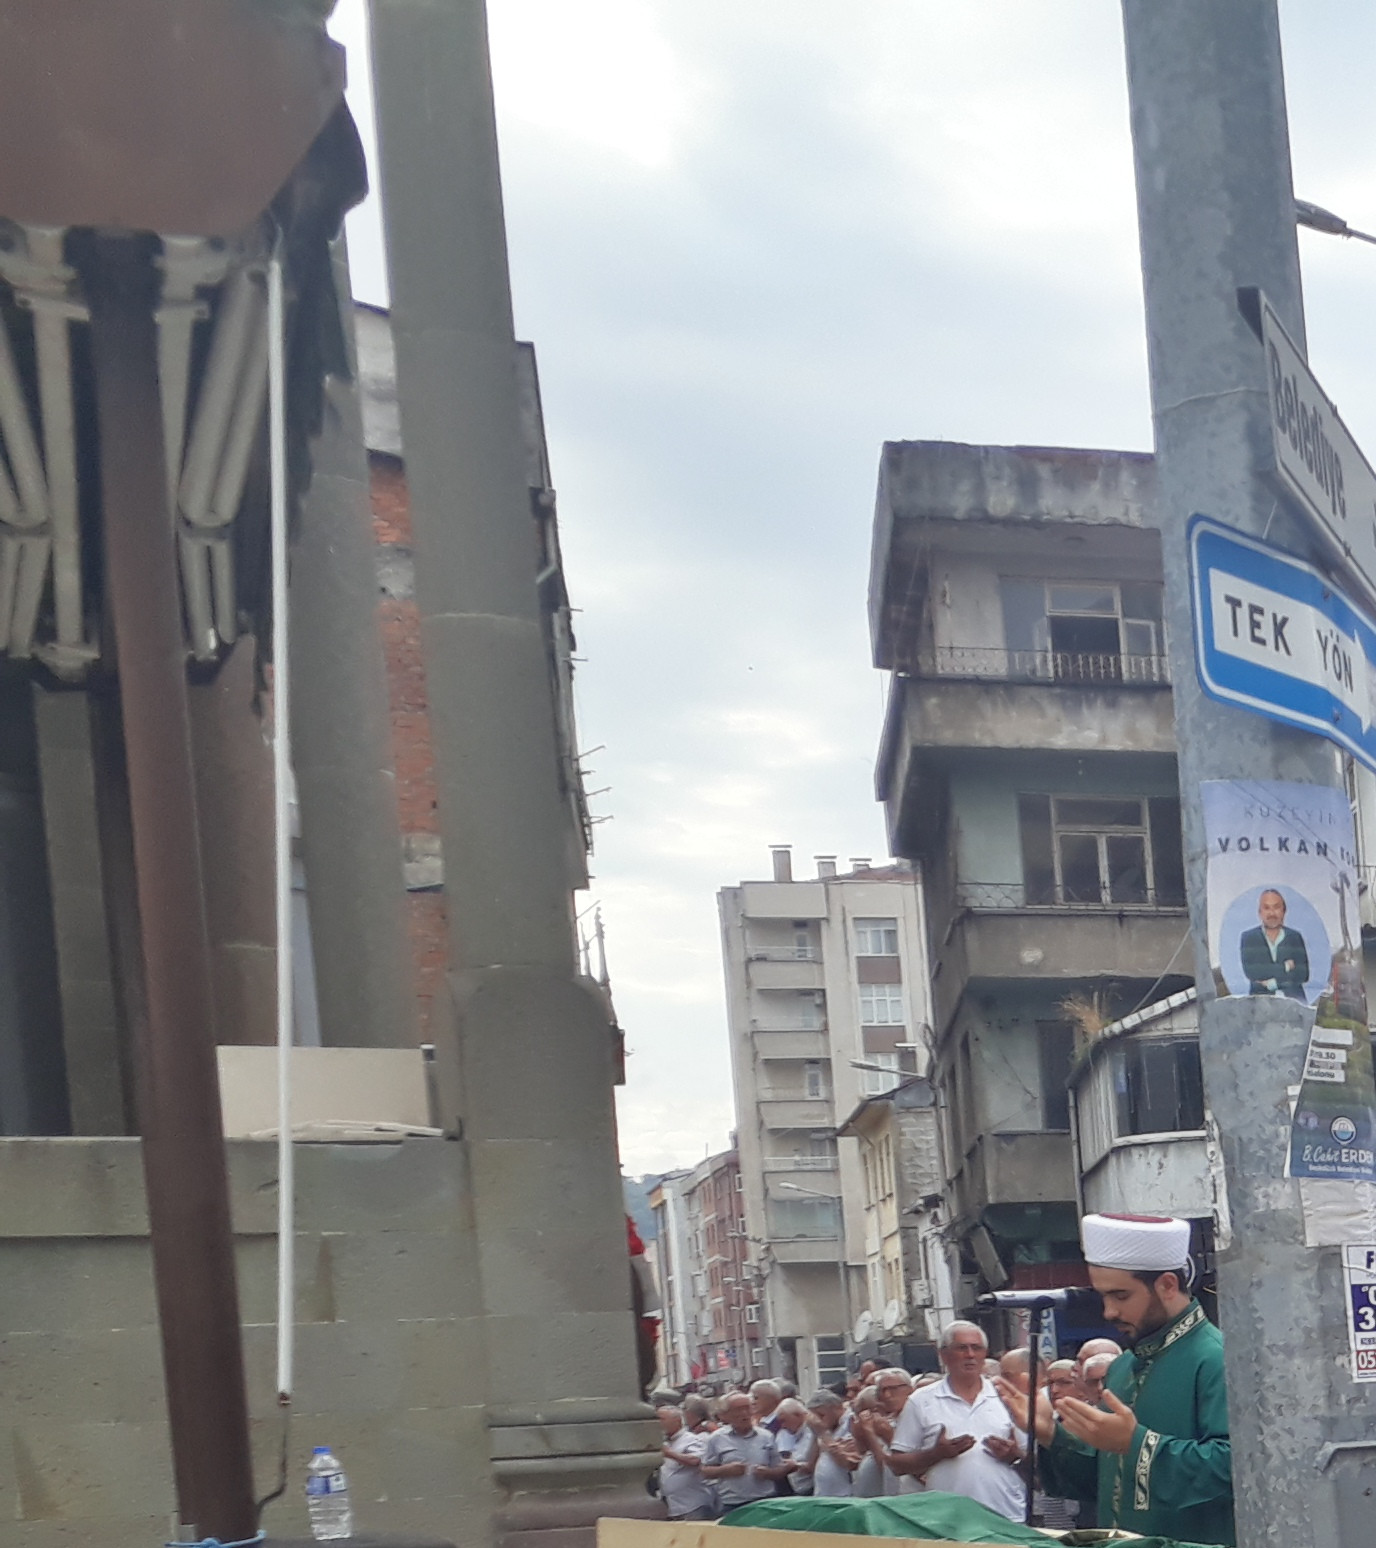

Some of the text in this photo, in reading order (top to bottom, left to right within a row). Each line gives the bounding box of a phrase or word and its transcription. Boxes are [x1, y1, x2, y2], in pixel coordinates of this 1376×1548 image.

[1268, 341, 1347, 521] Belediye
[1224, 593, 1355, 695] TEK YÖN
[1217, 835, 1329, 858] VOLKAN
